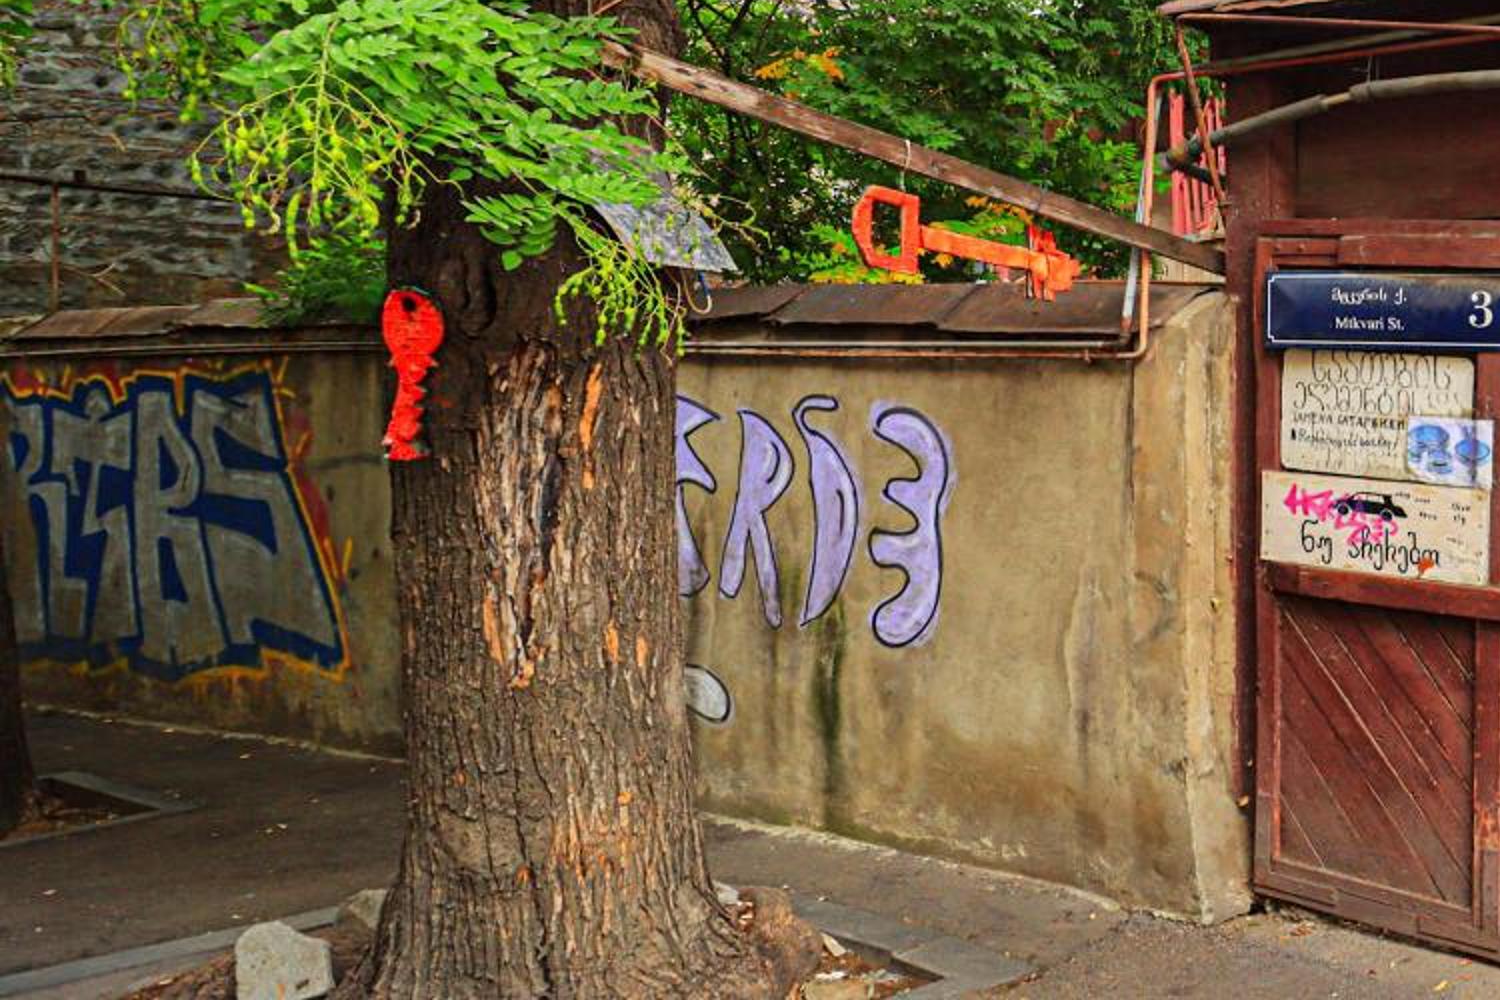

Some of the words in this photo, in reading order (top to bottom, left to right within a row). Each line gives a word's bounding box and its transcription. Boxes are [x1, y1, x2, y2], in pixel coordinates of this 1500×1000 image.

[1468, 290, 1493, 328] 3
[1335, 316, 1385, 331] Mtkvari
[1387, 317, 1406, 331] St.
